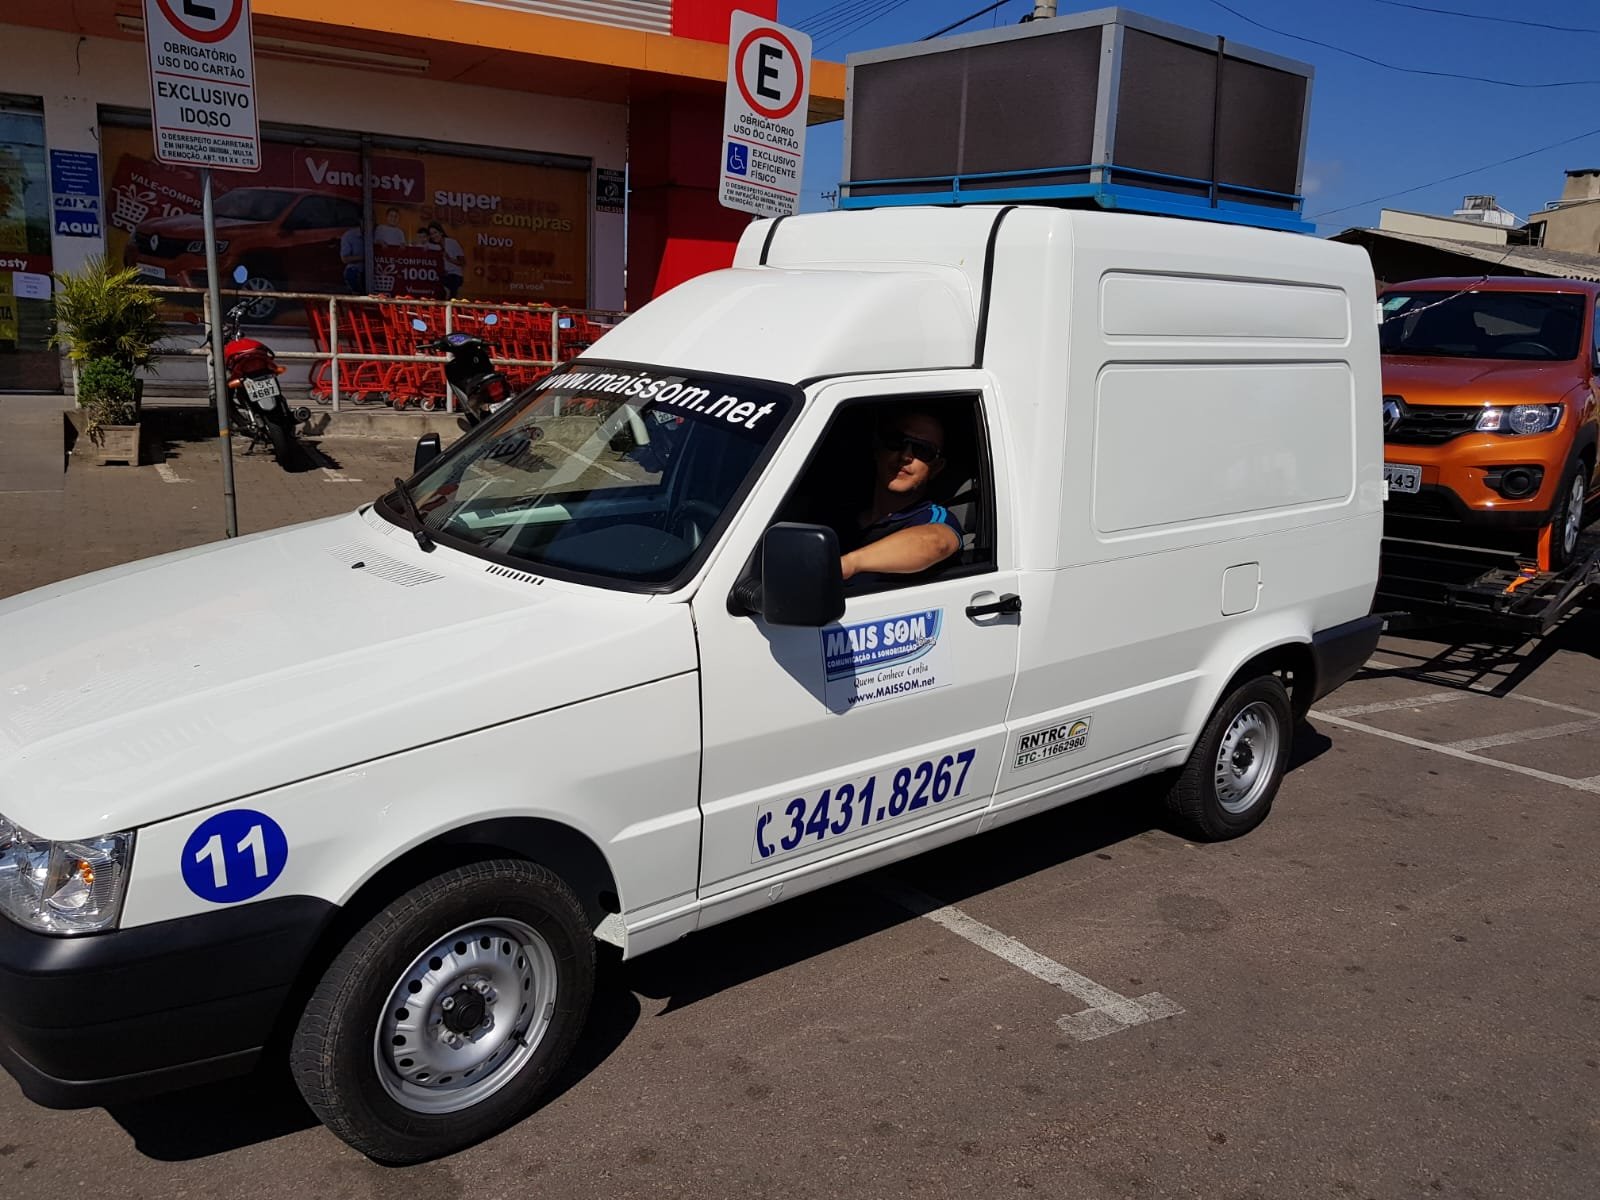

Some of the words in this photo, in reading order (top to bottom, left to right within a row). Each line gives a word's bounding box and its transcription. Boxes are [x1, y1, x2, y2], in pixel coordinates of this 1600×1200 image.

[164, 42, 237, 64] OBRIGATÓRIO
[157, 56, 180, 68] USO
[184, 60, 199, 72] DO
[202, 63, 245, 79] CARTÃO
[757, 43, 783, 101] E
[158, 81, 249, 108] EXCLUSIVO
[180, 107, 232, 128] IDOSO
[740, 114, 794, 136] OBRIGATÓRIO
[168, 134, 212, 144] DESRESPEITO
[176, 143, 207, 152] INFRAÇÃO
[734, 124, 750, 136] USO
[752, 128, 764, 140] DO
[766, 132, 798, 150] CARTÃO
[752, 148, 796, 168] EXCLUSIVO
[750, 170, 776, 184] FÍSICO
[752, 160, 796, 179] DEFICIENTE
[130, 172, 204, 209] VALE-COMPR
[434, 190, 500, 212] super
[55, 198, 98, 209] CAIXA
[58, 220, 99, 234] AQUI
[492, 214, 572, 232] compras
[478, 232, 514, 248] Novo
[536, 372, 776, 430] www.maissom.net
[826, 626, 878, 657] MAIS
[884, 617, 926, 646] SOM
[827, 653, 870, 668] COMUNICAÇÃO
[878, 644, 917, 657] SONORIZAÇÃO
[854, 676, 874, 689] Quem
[877, 669, 904, 683] Conhece
[907, 662, 928, 677] Confia
[848, 676, 935, 704] www.MAISSOM.net
[1020, 726, 1066, 750] RNTRC
[780, 748, 976, 850] 3431.8267
[196, 824, 268, 888] 11
